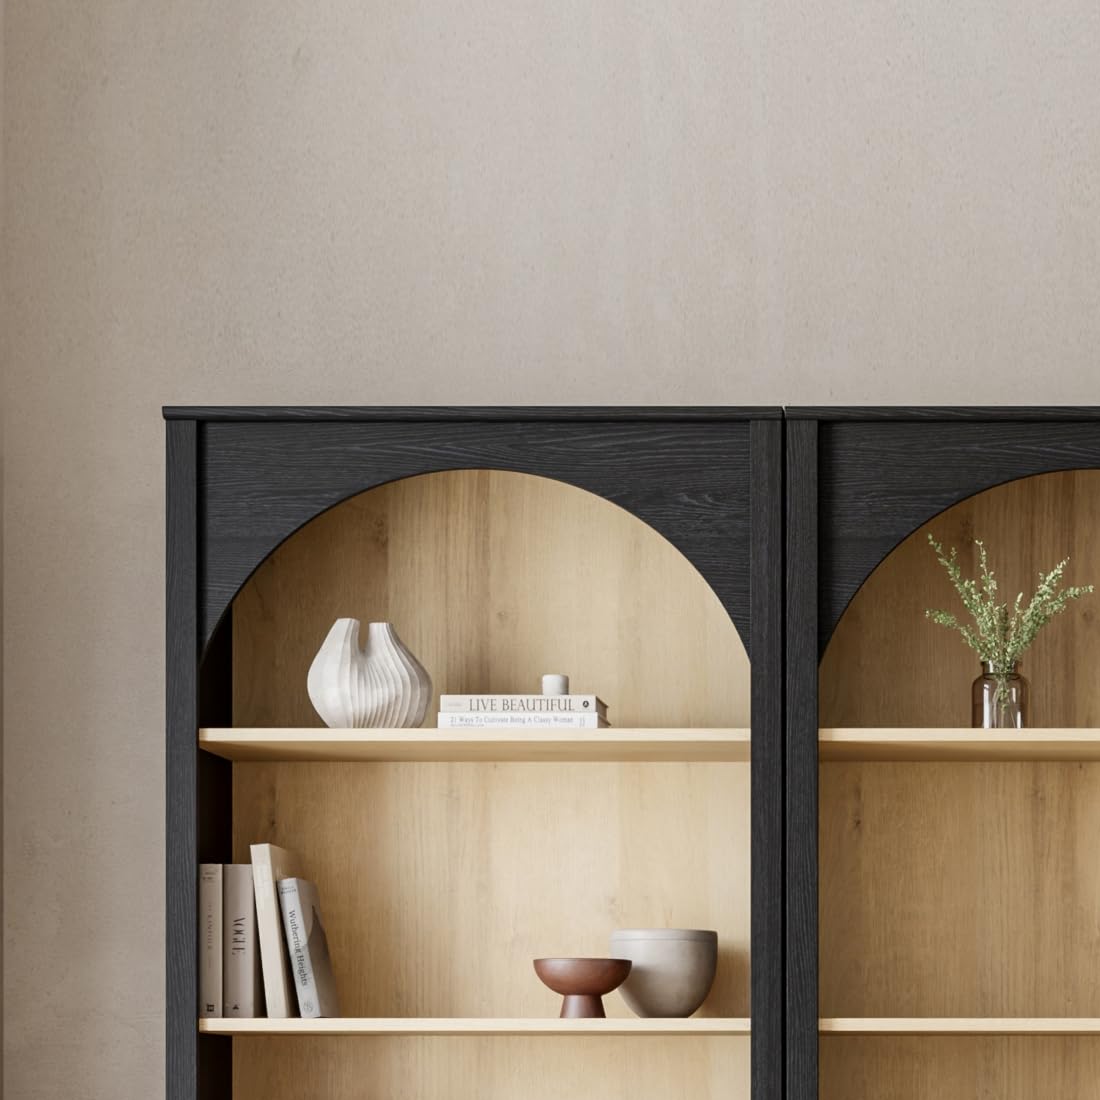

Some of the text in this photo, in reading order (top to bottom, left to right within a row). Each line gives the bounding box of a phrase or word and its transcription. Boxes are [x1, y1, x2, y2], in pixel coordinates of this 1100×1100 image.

[469, 698, 575, 712] LIVE BEAUTIFUL
[288, 909, 303, 954] Wuthering
[297, 954, 308, 987] Heights
